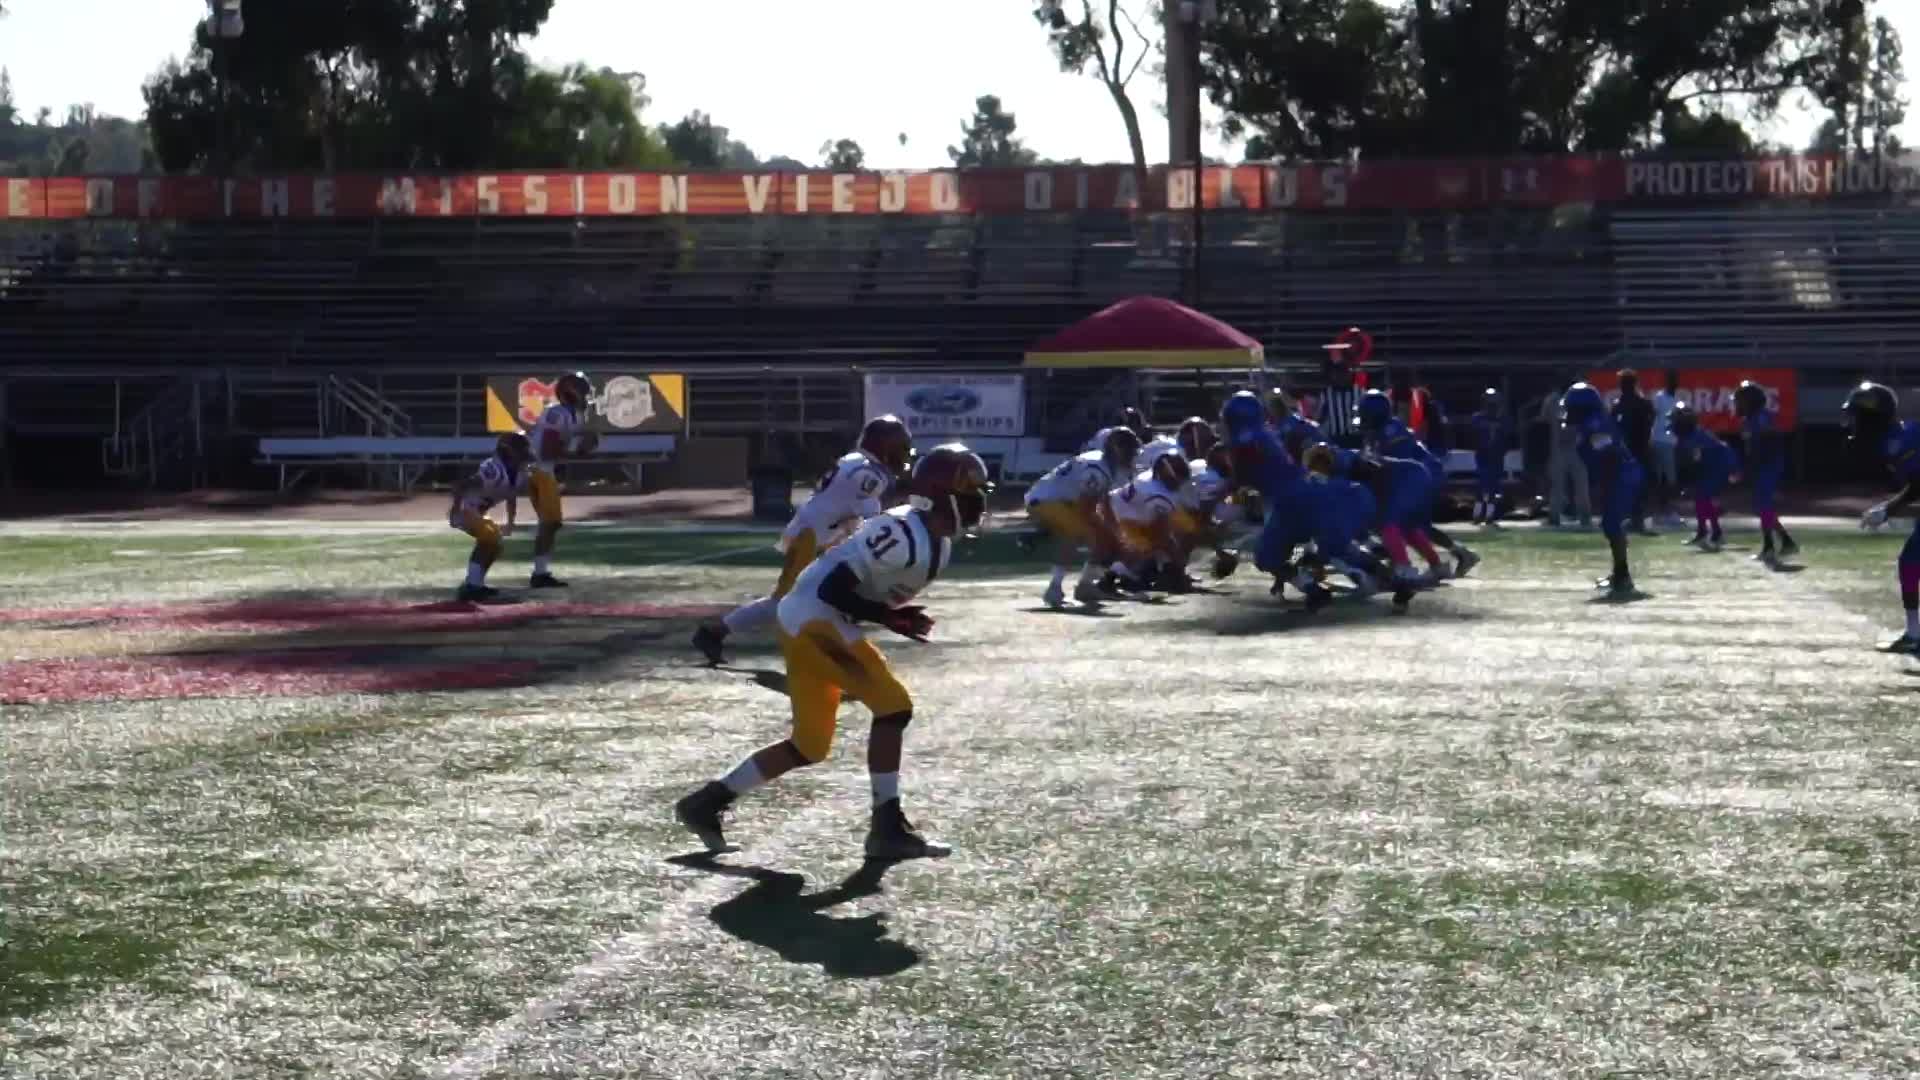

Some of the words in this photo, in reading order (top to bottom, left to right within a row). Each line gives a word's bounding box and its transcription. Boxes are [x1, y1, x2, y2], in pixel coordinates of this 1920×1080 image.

[87, 178, 158, 216] OF
[216, 178, 334, 216] THE
[379, 175, 688, 215] MISSION
[742, 174, 960, 213] VIEJO
[1024, 170, 1346, 209] DIABLOS
[1626, 160, 1755, 194] PROTECT
[1768, 159, 1822, 193] THIS
[1826, 158, 1919, 193] HOUS
[866, 525, 900, 560] 31
